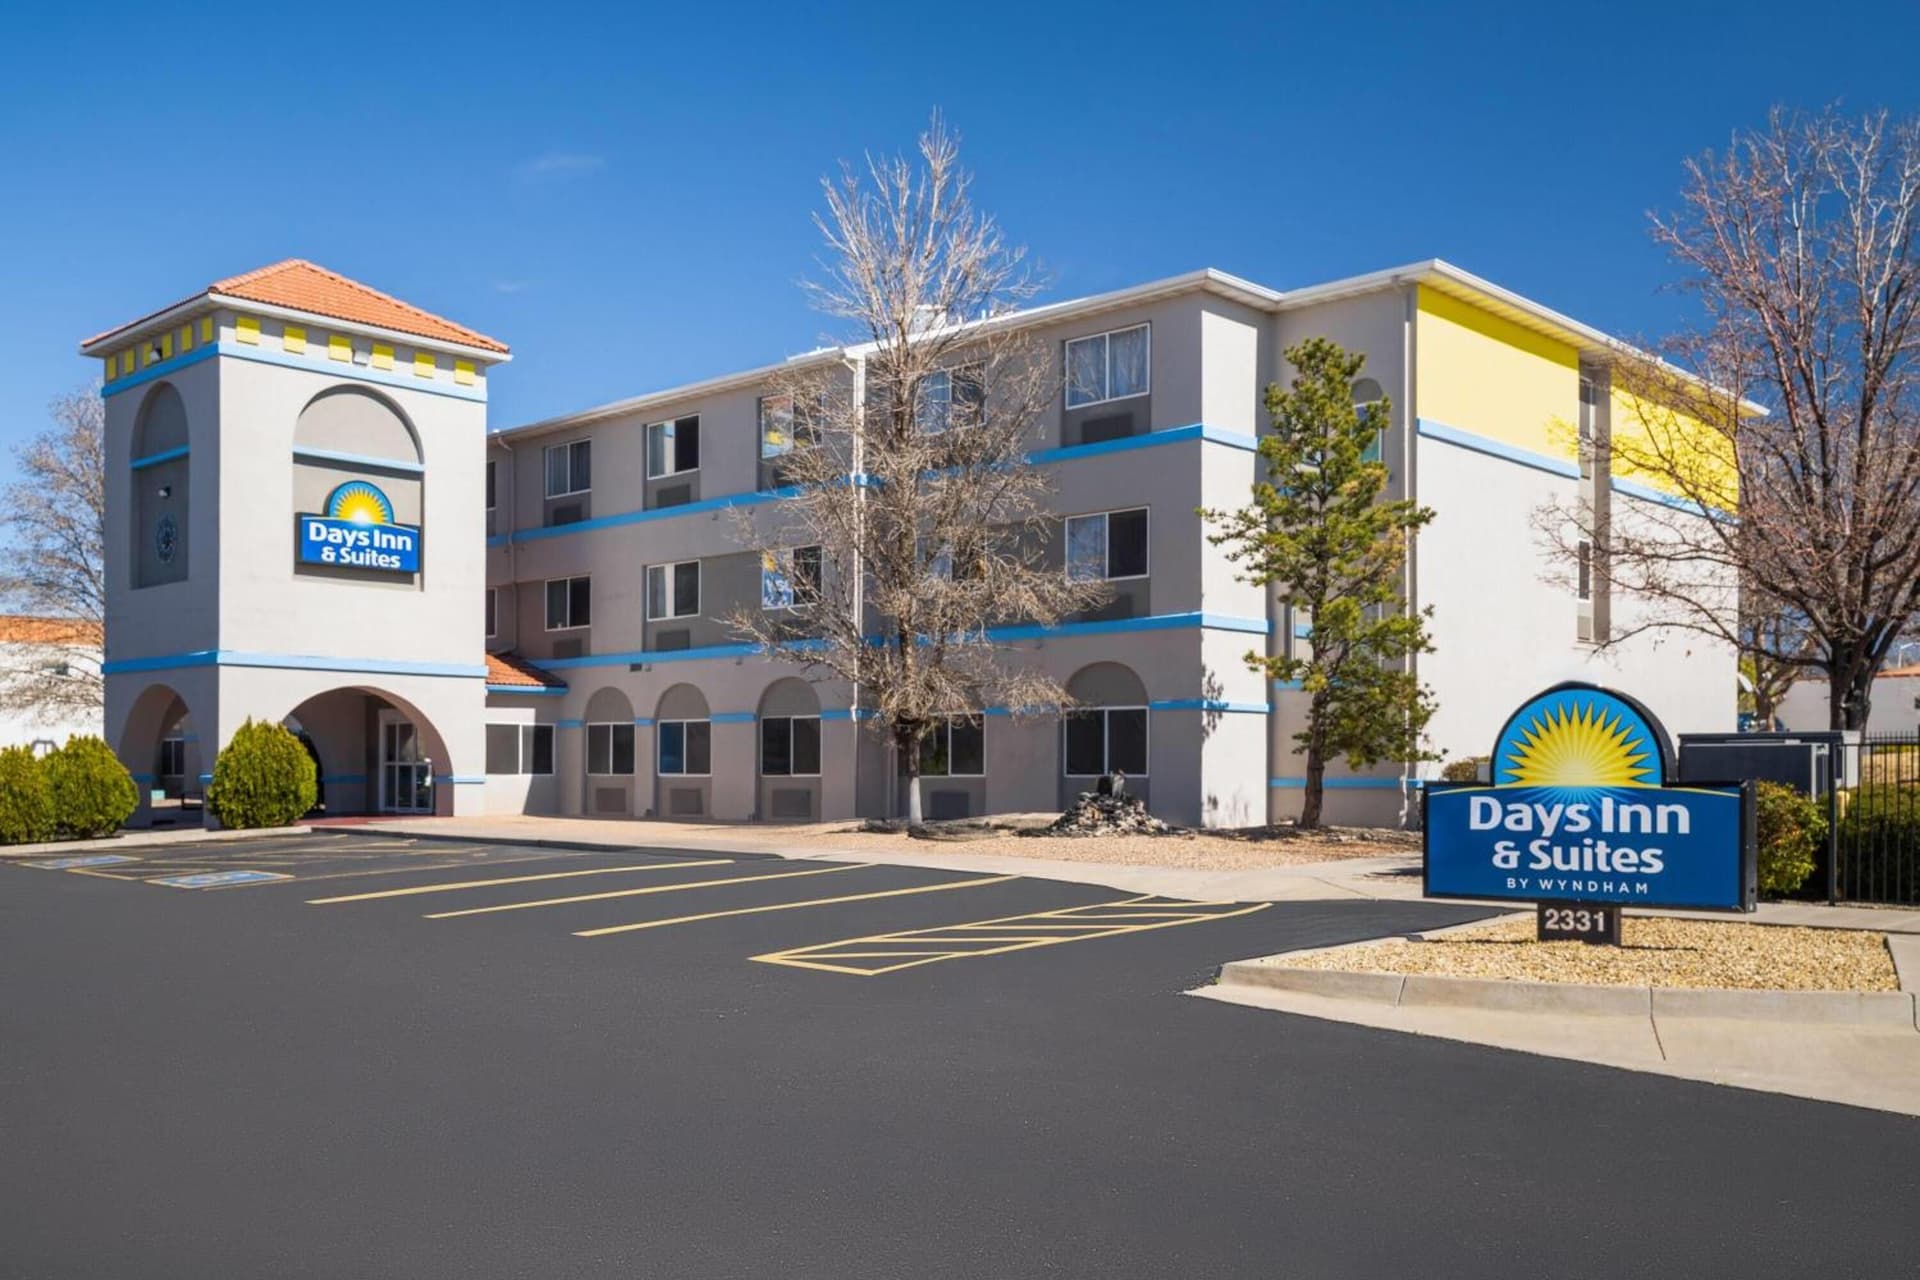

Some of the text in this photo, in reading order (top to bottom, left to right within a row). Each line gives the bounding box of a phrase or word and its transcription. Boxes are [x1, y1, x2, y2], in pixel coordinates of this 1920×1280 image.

[309, 522, 412, 551] Days Inn
[321, 546, 401, 568] & Suites
[1469, 796, 1690, 837] Days Inn
[1492, 838, 1664, 874] & Suites
[1506, 877, 1649, 894] BY WYNDHAM
[1544, 908, 1606, 932] 2331
